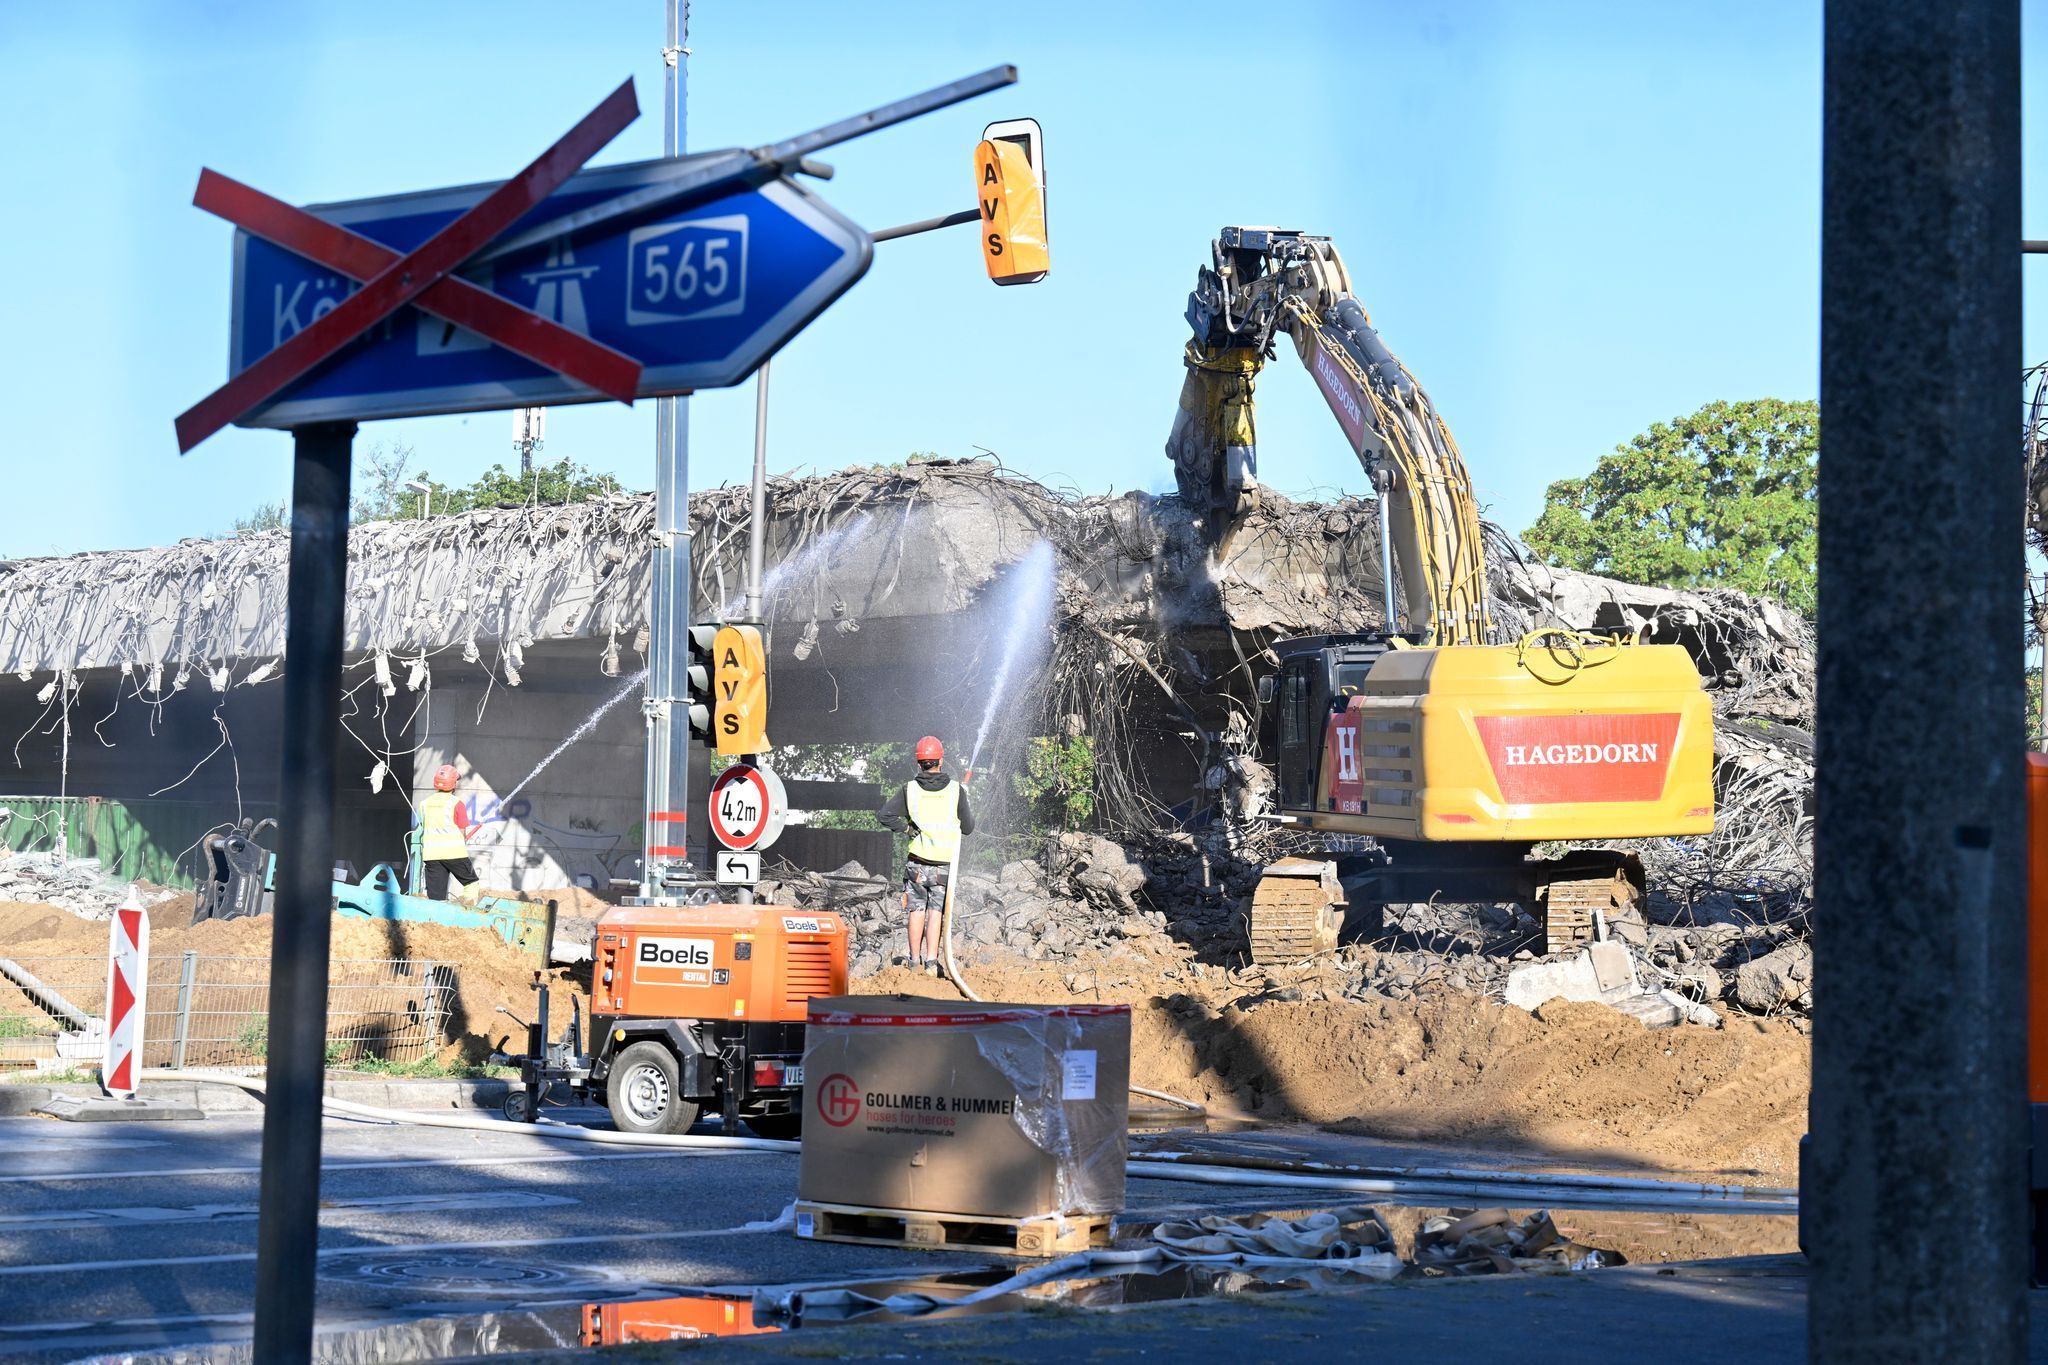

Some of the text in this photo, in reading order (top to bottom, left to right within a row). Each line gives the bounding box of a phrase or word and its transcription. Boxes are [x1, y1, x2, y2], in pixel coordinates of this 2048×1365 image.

[983, 162, 1003, 256] AVS
[645, 238, 729, 303] 565
[1318, 353, 1361, 425] HAGEDORN
[721, 647, 741, 735] AVS
[1336, 727, 1358, 780] H
[1505, 743, 1658, 765] HAGEDORN
[785, 920, 818, 931] Boels
[640, 943, 709, 965] Boels
[682, 971, 708, 982] RENTAL
[866, 1092, 931, 1111] GOLLMER
[936, 1096, 946, 1111] &
[866, 1110, 956, 1126] hoses for heroes
